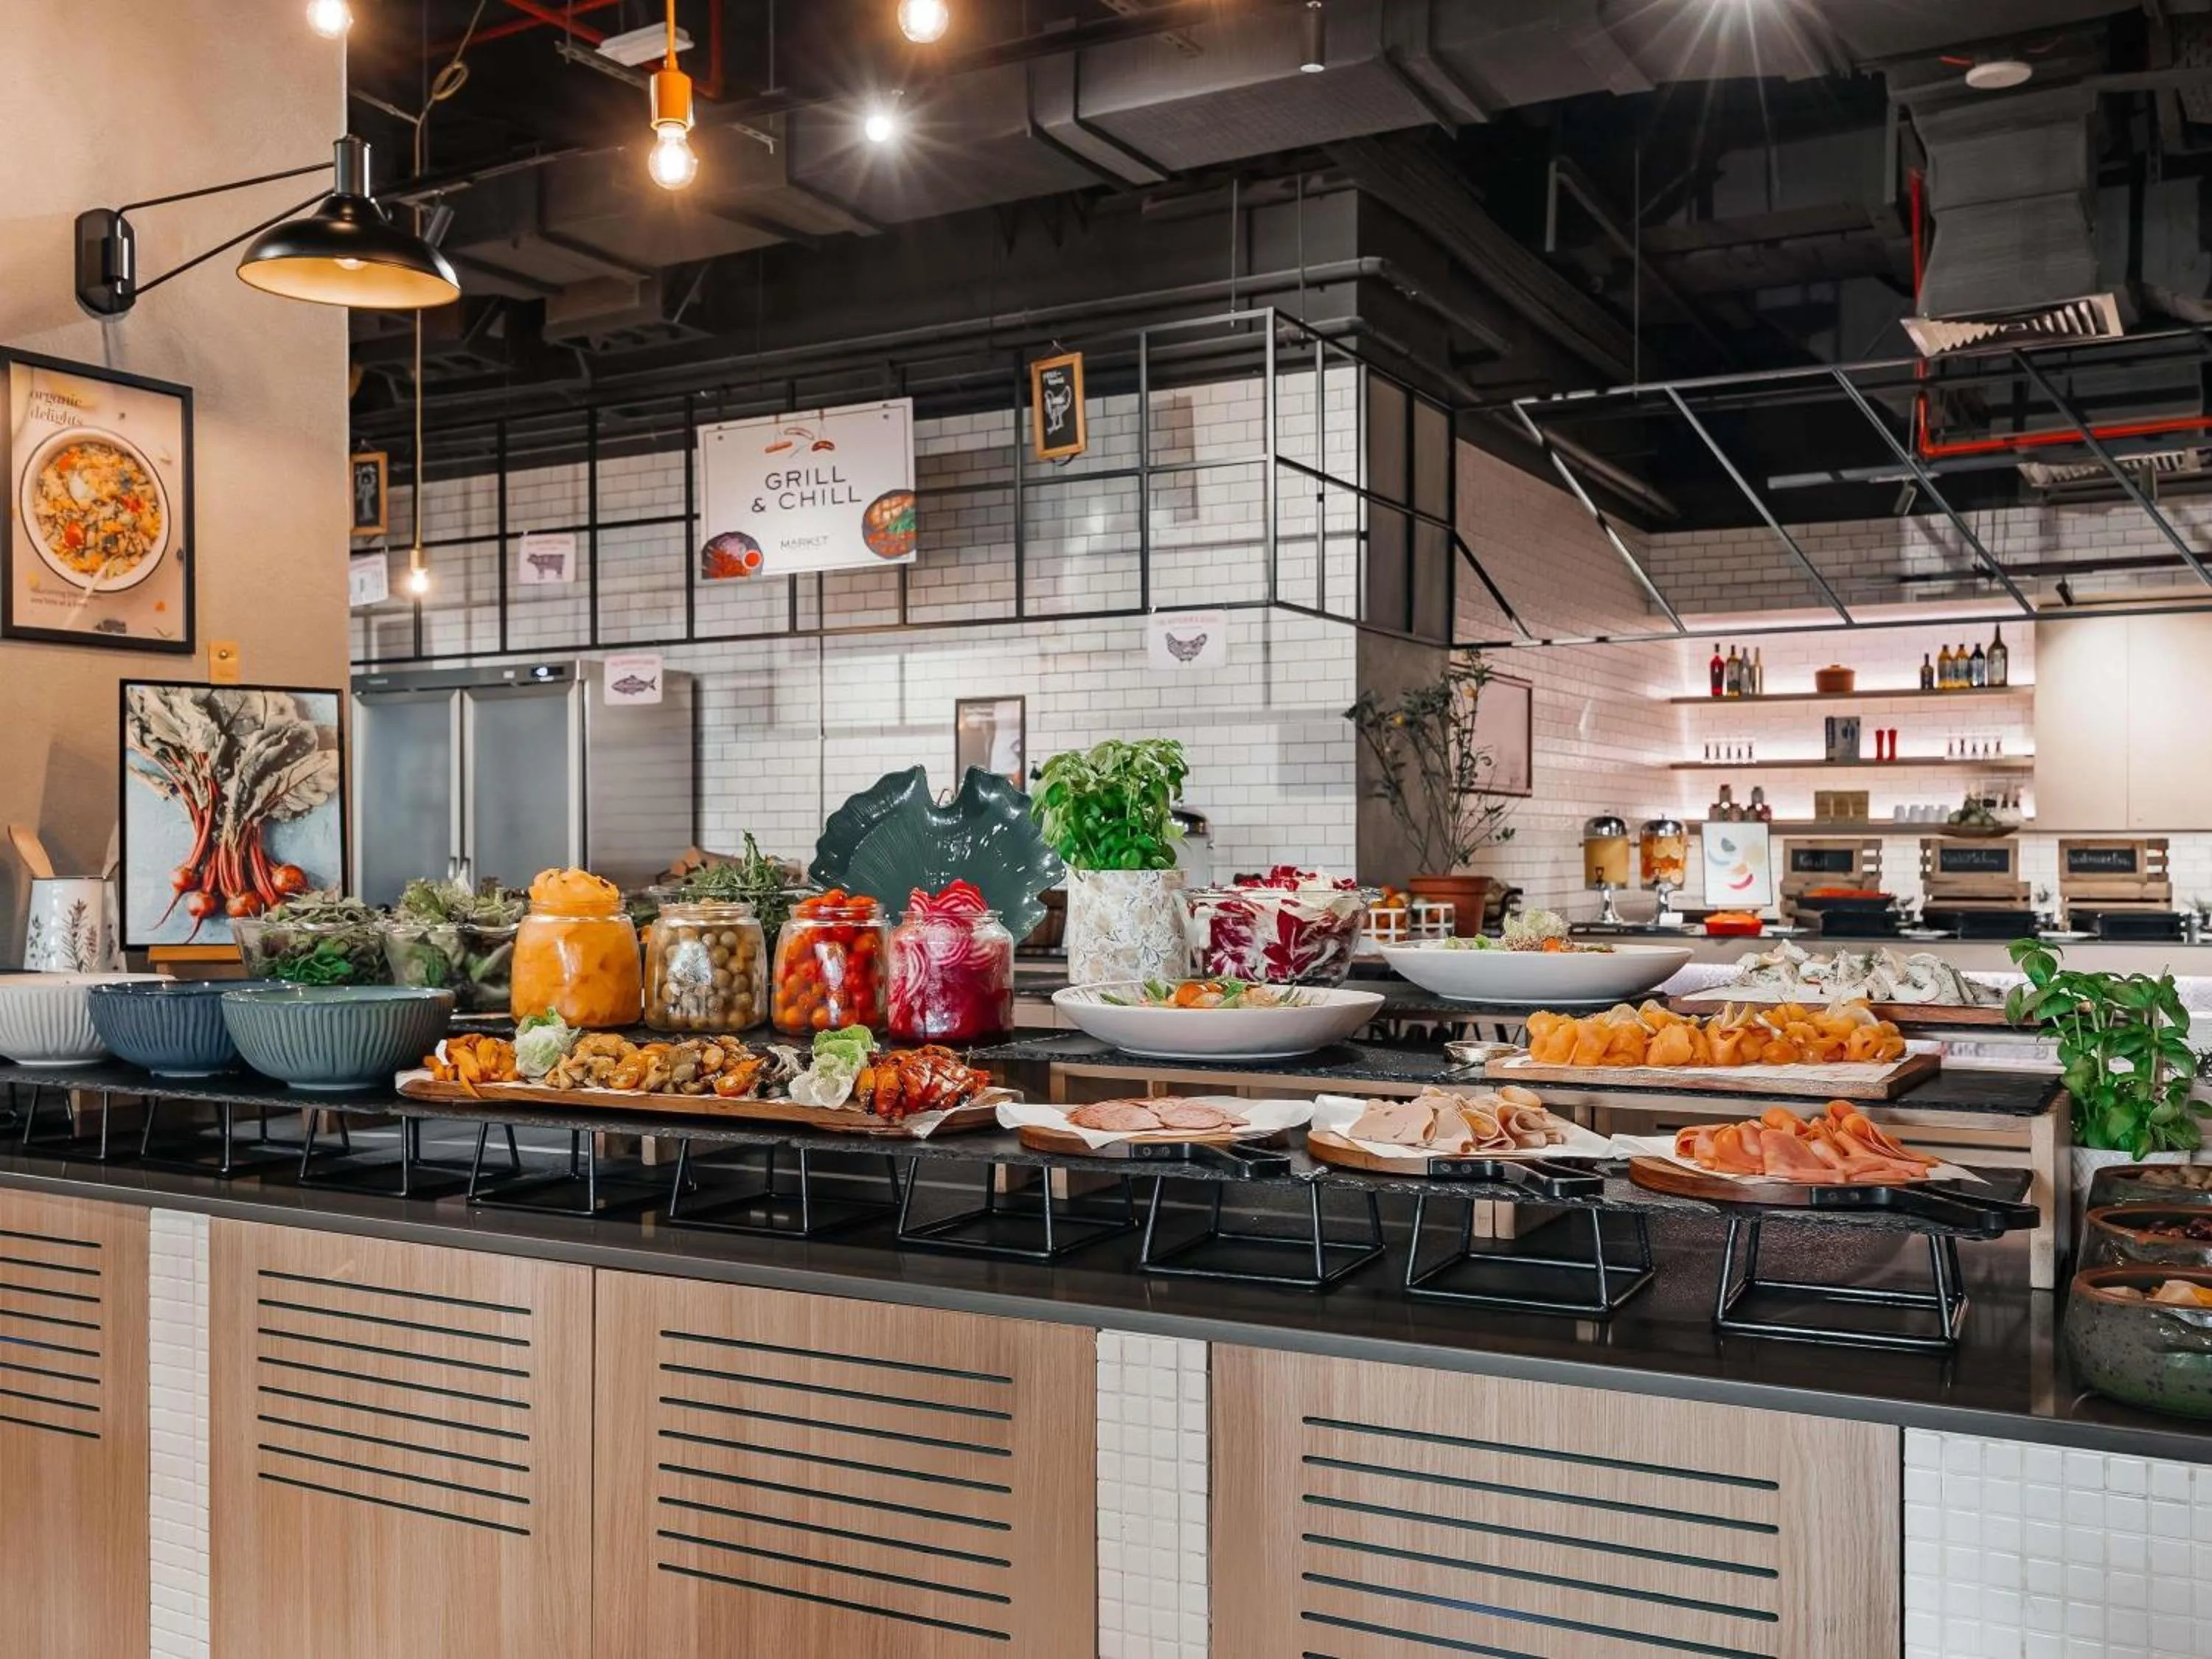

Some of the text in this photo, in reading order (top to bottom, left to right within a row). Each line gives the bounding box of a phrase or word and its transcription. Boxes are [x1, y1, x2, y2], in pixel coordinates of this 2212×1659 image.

[29, 389, 83, 408] organic
[30, 406, 83, 425] delights
[765, 466, 846, 490] GRILL
[751, 486, 862, 512] & CHILL
